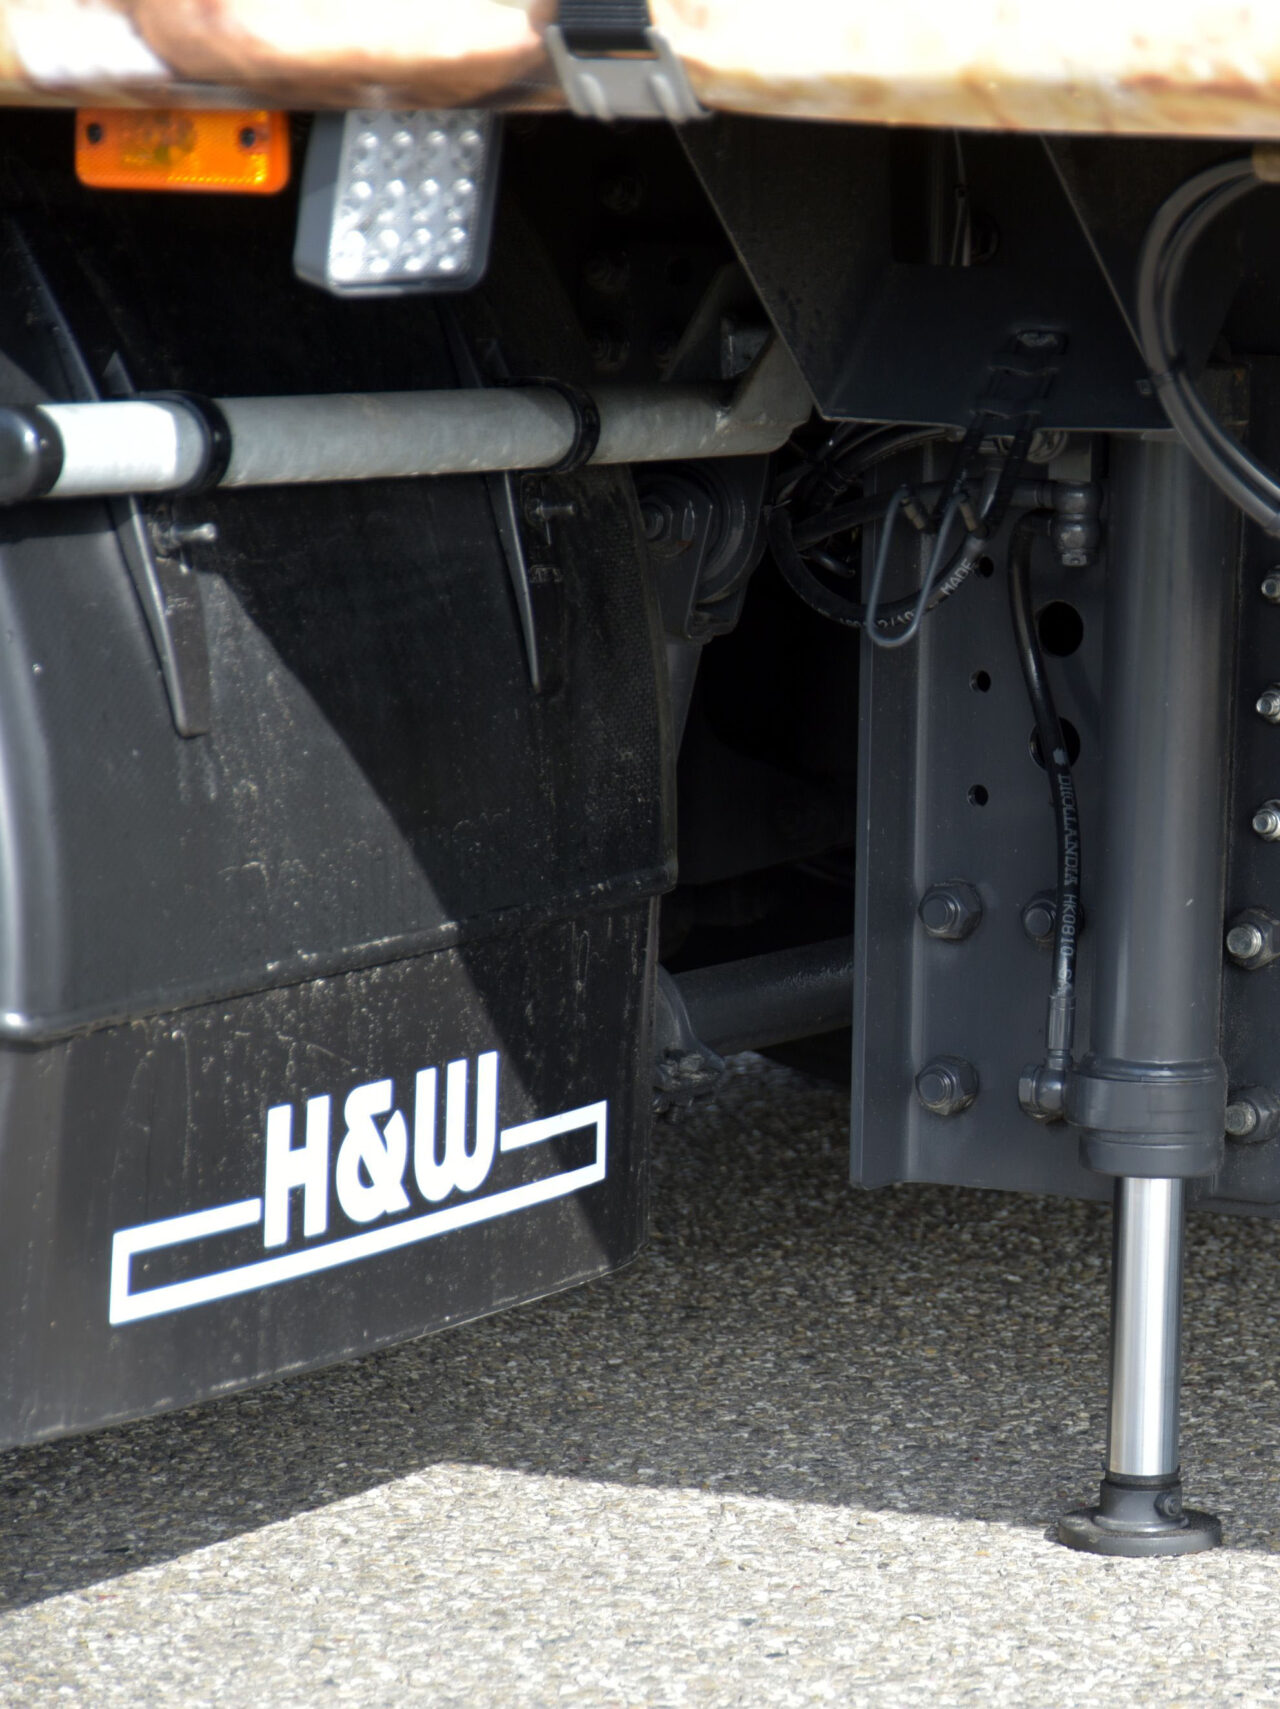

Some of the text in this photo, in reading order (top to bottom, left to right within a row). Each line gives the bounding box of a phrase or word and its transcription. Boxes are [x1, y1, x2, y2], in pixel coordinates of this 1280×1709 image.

[940, 556, 974, 596] MADE
[1057, 773, 1079, 887] DHOLLANDIA
[1060, 893, 1077, 957] HK0810
[264, 1051, 499, 1249] H&W
